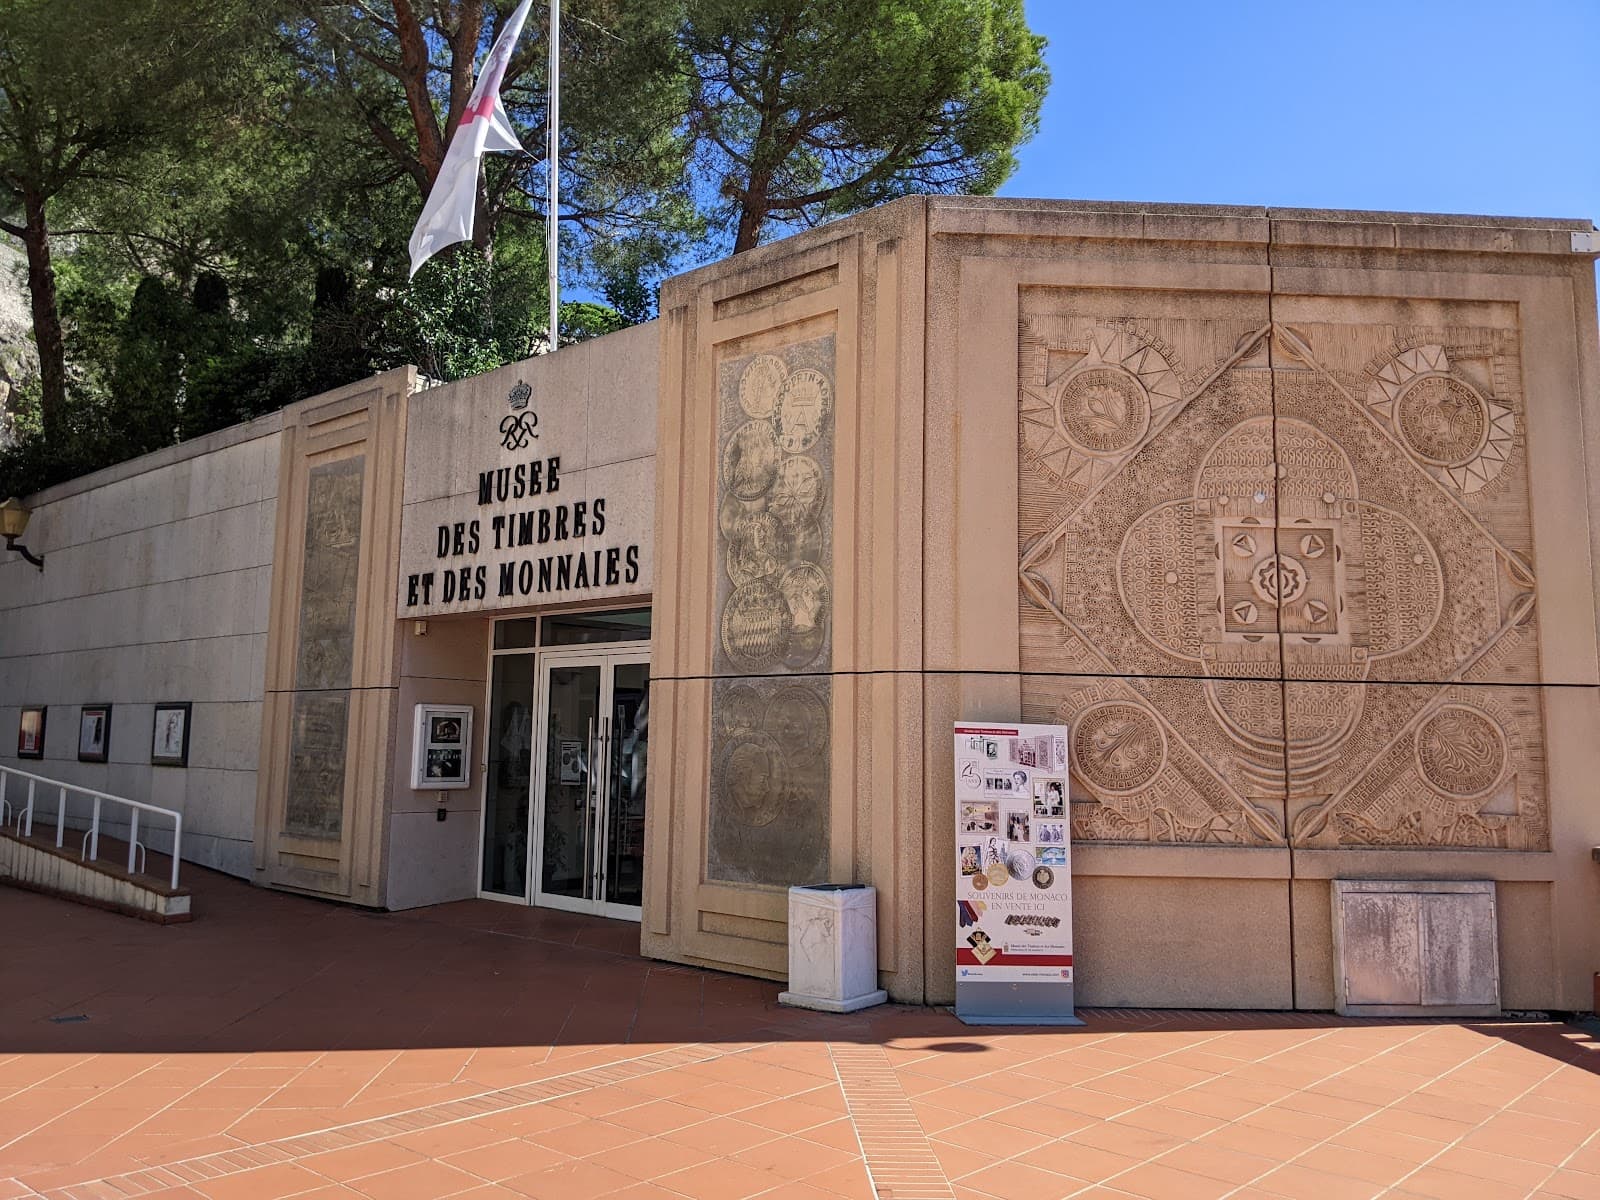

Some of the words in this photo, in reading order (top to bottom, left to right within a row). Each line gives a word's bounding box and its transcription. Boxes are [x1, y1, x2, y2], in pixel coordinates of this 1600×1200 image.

[477, 456, 561, 506] MUSEE
[437, 520, 480, 558] DES
[492, 498, 606, 550] TIMBRES
[406, 572, 434, 607] ET
[441, 565, 487, 603] DES
[498, 545, 640, 597] MONNAIES
[968, 891, 1014, 900] SOUVENIRS
[1016, 893, 1027, 901] DE
[1030, 893, 1068, 902] MONACO
[991, 902, 1003, 910] EN
[1005, 903, 1032, 911] VENTE
[1034, 903, 1045, 911] ICI
